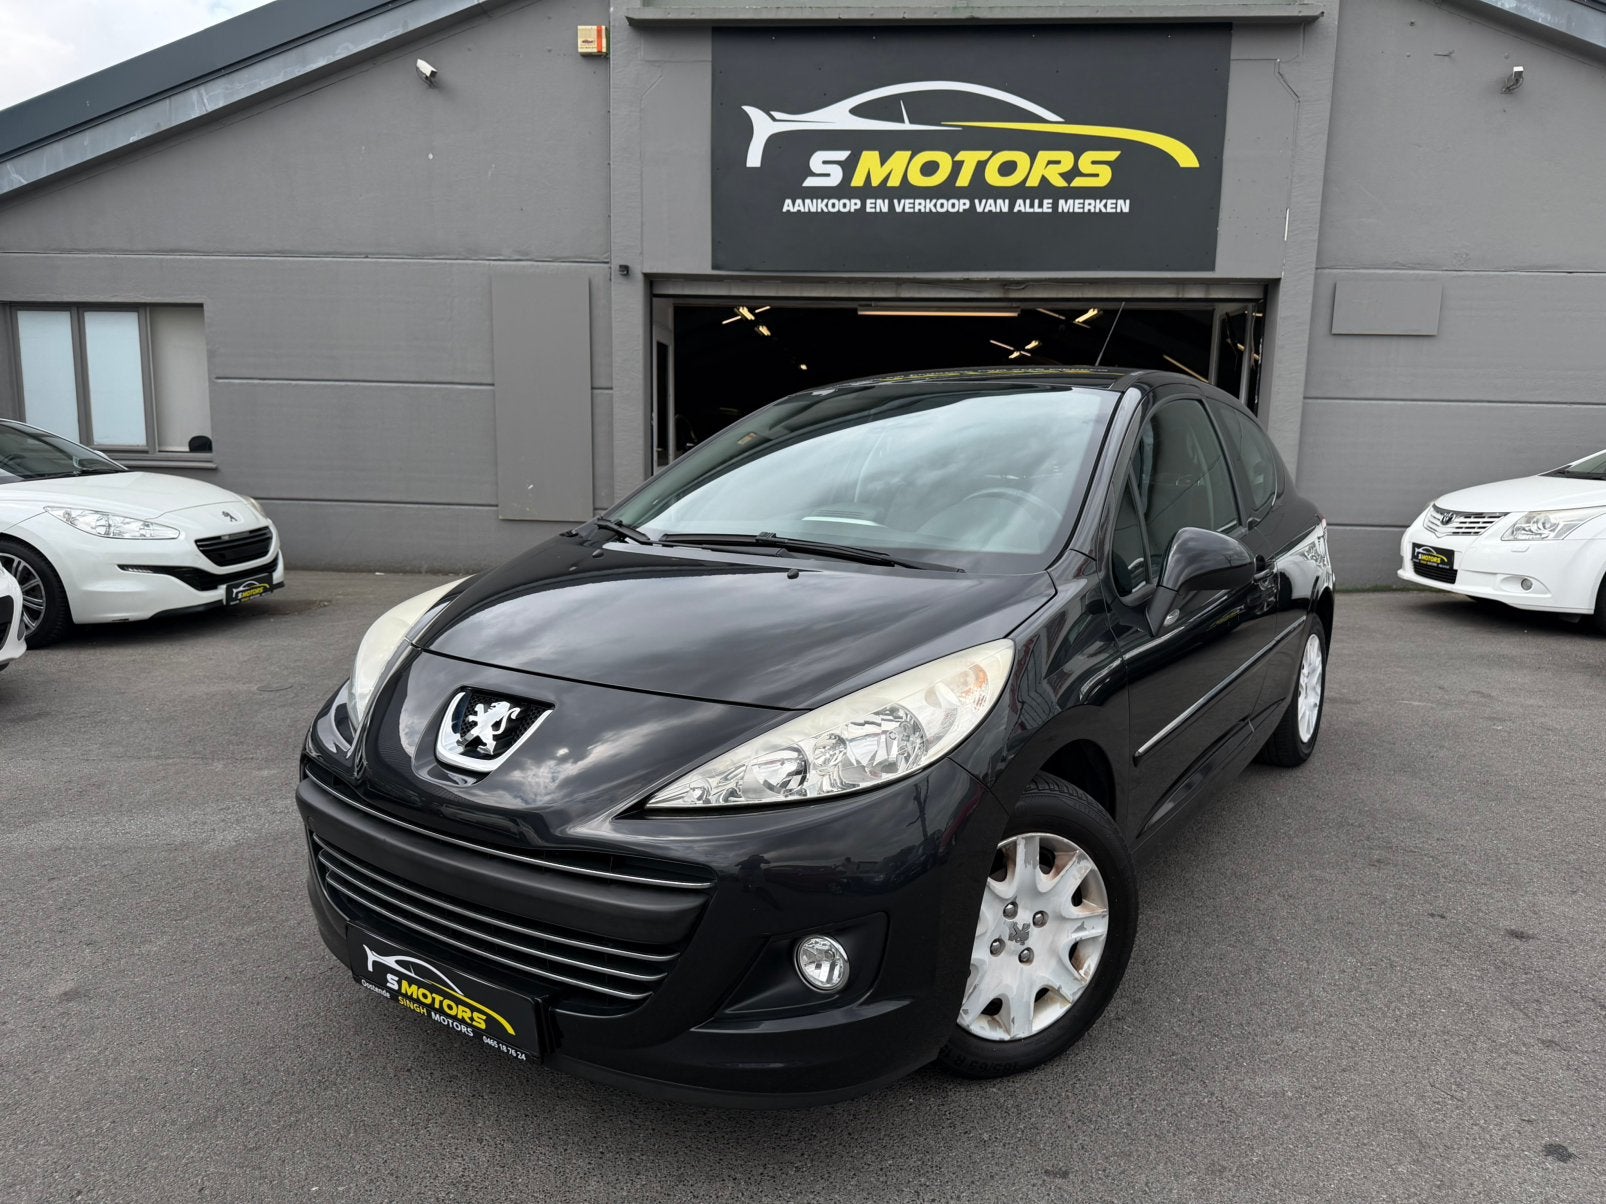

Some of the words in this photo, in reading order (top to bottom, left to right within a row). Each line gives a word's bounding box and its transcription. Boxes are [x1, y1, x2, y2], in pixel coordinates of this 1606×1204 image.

[802, 150, 852, 187] S
[851, 150, 1122, 188] MOTORS
[782, 198, 862, 213] AANKOOP
[865, 198, 889, 213] EN
[893, 198, 971, 213] VERKOOP
[974, 198, 1010, 213] VAN
[1013, 198, 1053, 213] ALLE
[1057, 198, 1130, 213] MERKEN
[361, 979, 391, 999] Oostende
[398, 996, 428, 1016] SINGH
[431, 1011, 474, 1037] MOTORS
[517, 1051, 527, 1061] 24
[386, 973, 400, 991] S
[401, 979, 487, 1030] MOTORS
